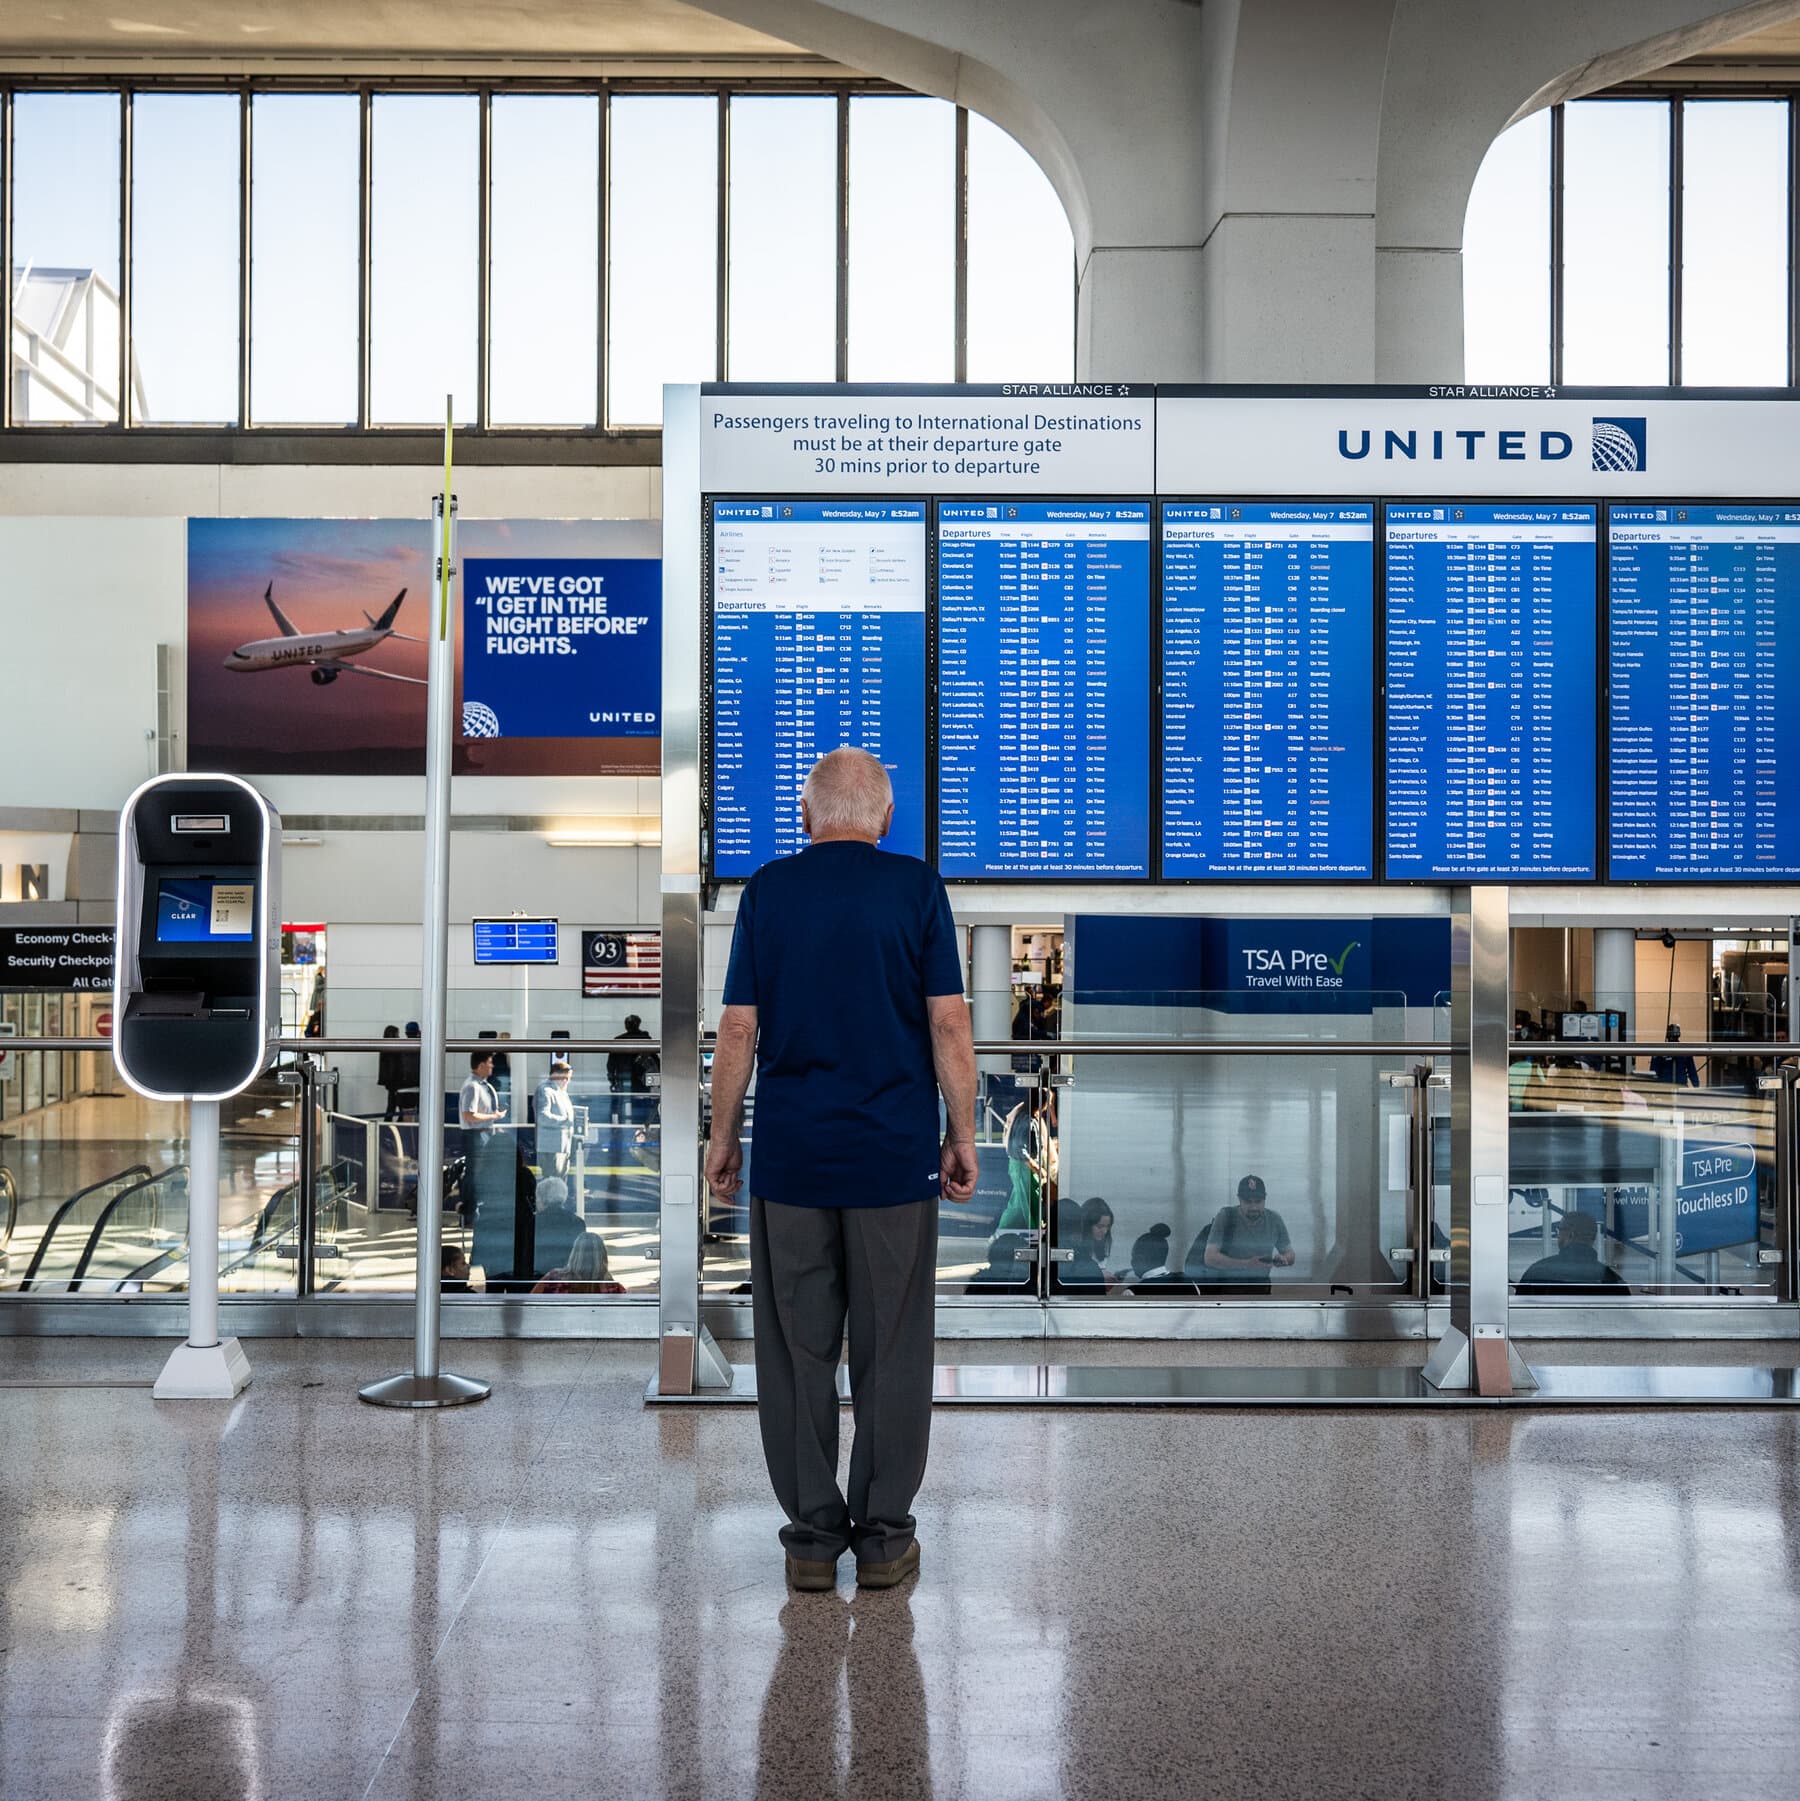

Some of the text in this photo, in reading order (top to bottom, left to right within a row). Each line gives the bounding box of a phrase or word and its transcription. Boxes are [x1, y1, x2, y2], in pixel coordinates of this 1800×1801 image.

[1002, 384, 1112, 395] STAR ALLIANCE
[1429, 386, 1539, 397] STAR ALLIANCE
[714, 413, 1142, 433] Passengers traveling to International Destinations
[793, 436, 1062, 456] must be at their departure gate
[1338, 430, 1573, 460] UNITED
[815, 458, 1040, 478] 30 mins prior to departure
[718, 508, 760, 516] UNITED
[822, 510, 862, 518] Wednesday,
[865, 510, 880, 518] May
[890, 510, 920, 518] 8:52am
[1046, 511, 1088, 520] Wednesday,
[1089, 511, 1104, 520] May
[1270, 512, 1312, 520] Wednesday,
[1312, 512, 1328, 520] May
[1493, 513, 1534, 521] Wednesday,
[1716, 514, 1757, 522] Wednesday,
[942, 528, 991, 539] Departures
[1166, 530, 1214, 540] Departures
[1389, 531, 1438, 542] Departures
[1612, 532, 1660, 543] Departures
[486, 576, 604, 594] WE’VE GOT
[497, 596, 537, 614] GET
[541, 597, 563, 614] IN
[567, 597, 607, 614] THE
[718, 601, 766, 610] Departures
[487, 617, 648, 634] NIGHT BEFORE”
[487, 637, 577, 654] FLIGHTS.
[272, 644, 322, 660] UNITED
[590, 712, 656, 722] UNITED
[0, 864, 48, 899] N
[16, 933, 69, 946] Economy
[594, 942, 617, 958] 93
[8, 955, 56, 968] Security
[1242, 949, 1328, 970] TSA Pre
[73, 977, 89, 987] All
[1246, 975, 1343, 987] Travel With Ease
[1692, 1158, 1732, 1177] TSA Pre
[1676, 1186, 1748, 1215] Touchless ID
